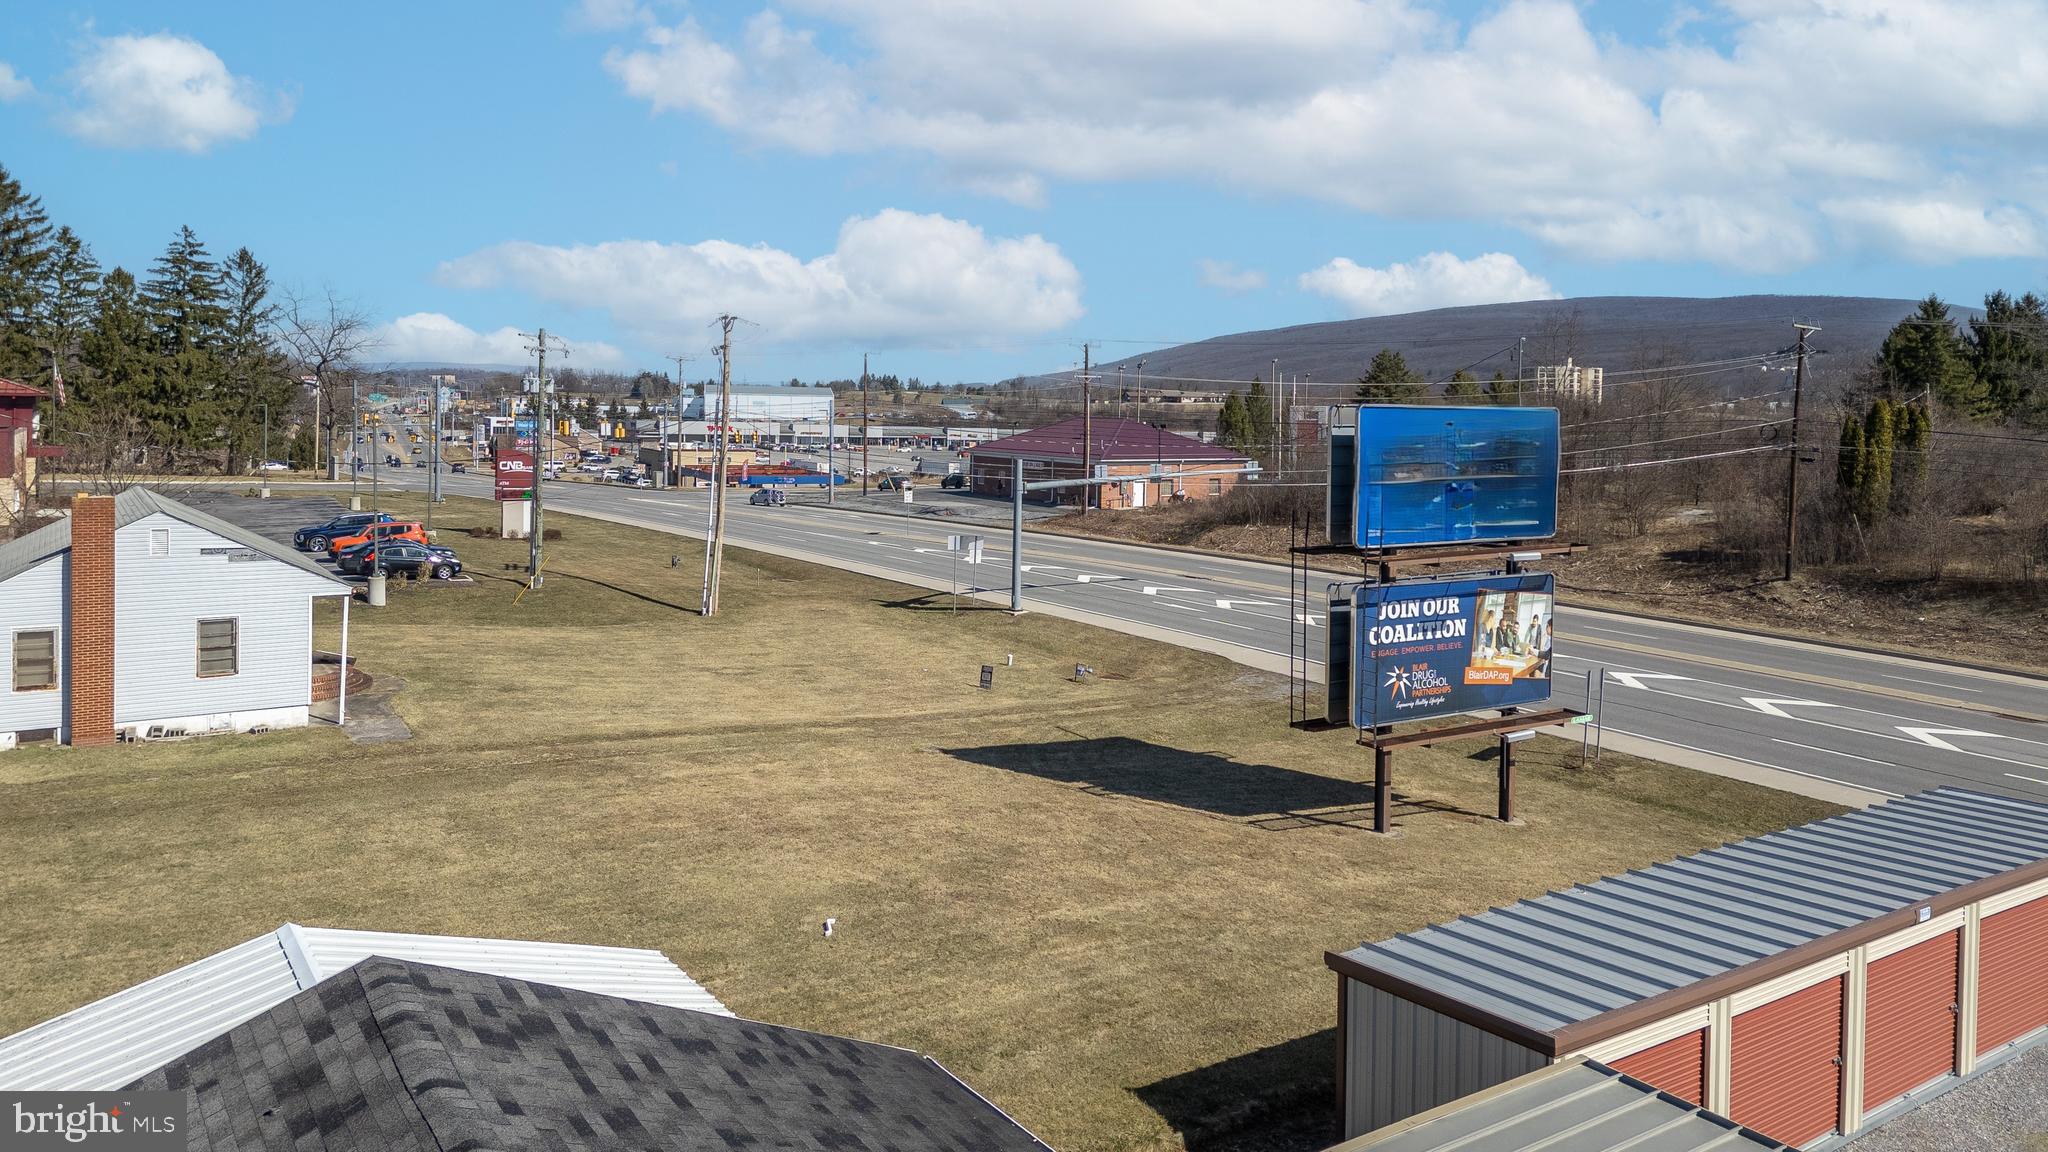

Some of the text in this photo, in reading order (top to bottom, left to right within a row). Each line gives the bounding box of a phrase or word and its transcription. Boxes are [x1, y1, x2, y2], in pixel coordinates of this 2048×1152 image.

[500, 461, 523, 470] CNB
[1379, 597, 1460, 621] JOIN OUR
[1369, 619, 1467, 646] COALITION
[1412, 662, 1428, 671] BLAIR
[1468, 670, 1510, 682] BlairDAP.org
[1412, 677, 1448, 689] ALCOHOL
[1412, 685, 1452, 697] PARTNERSHIPS
